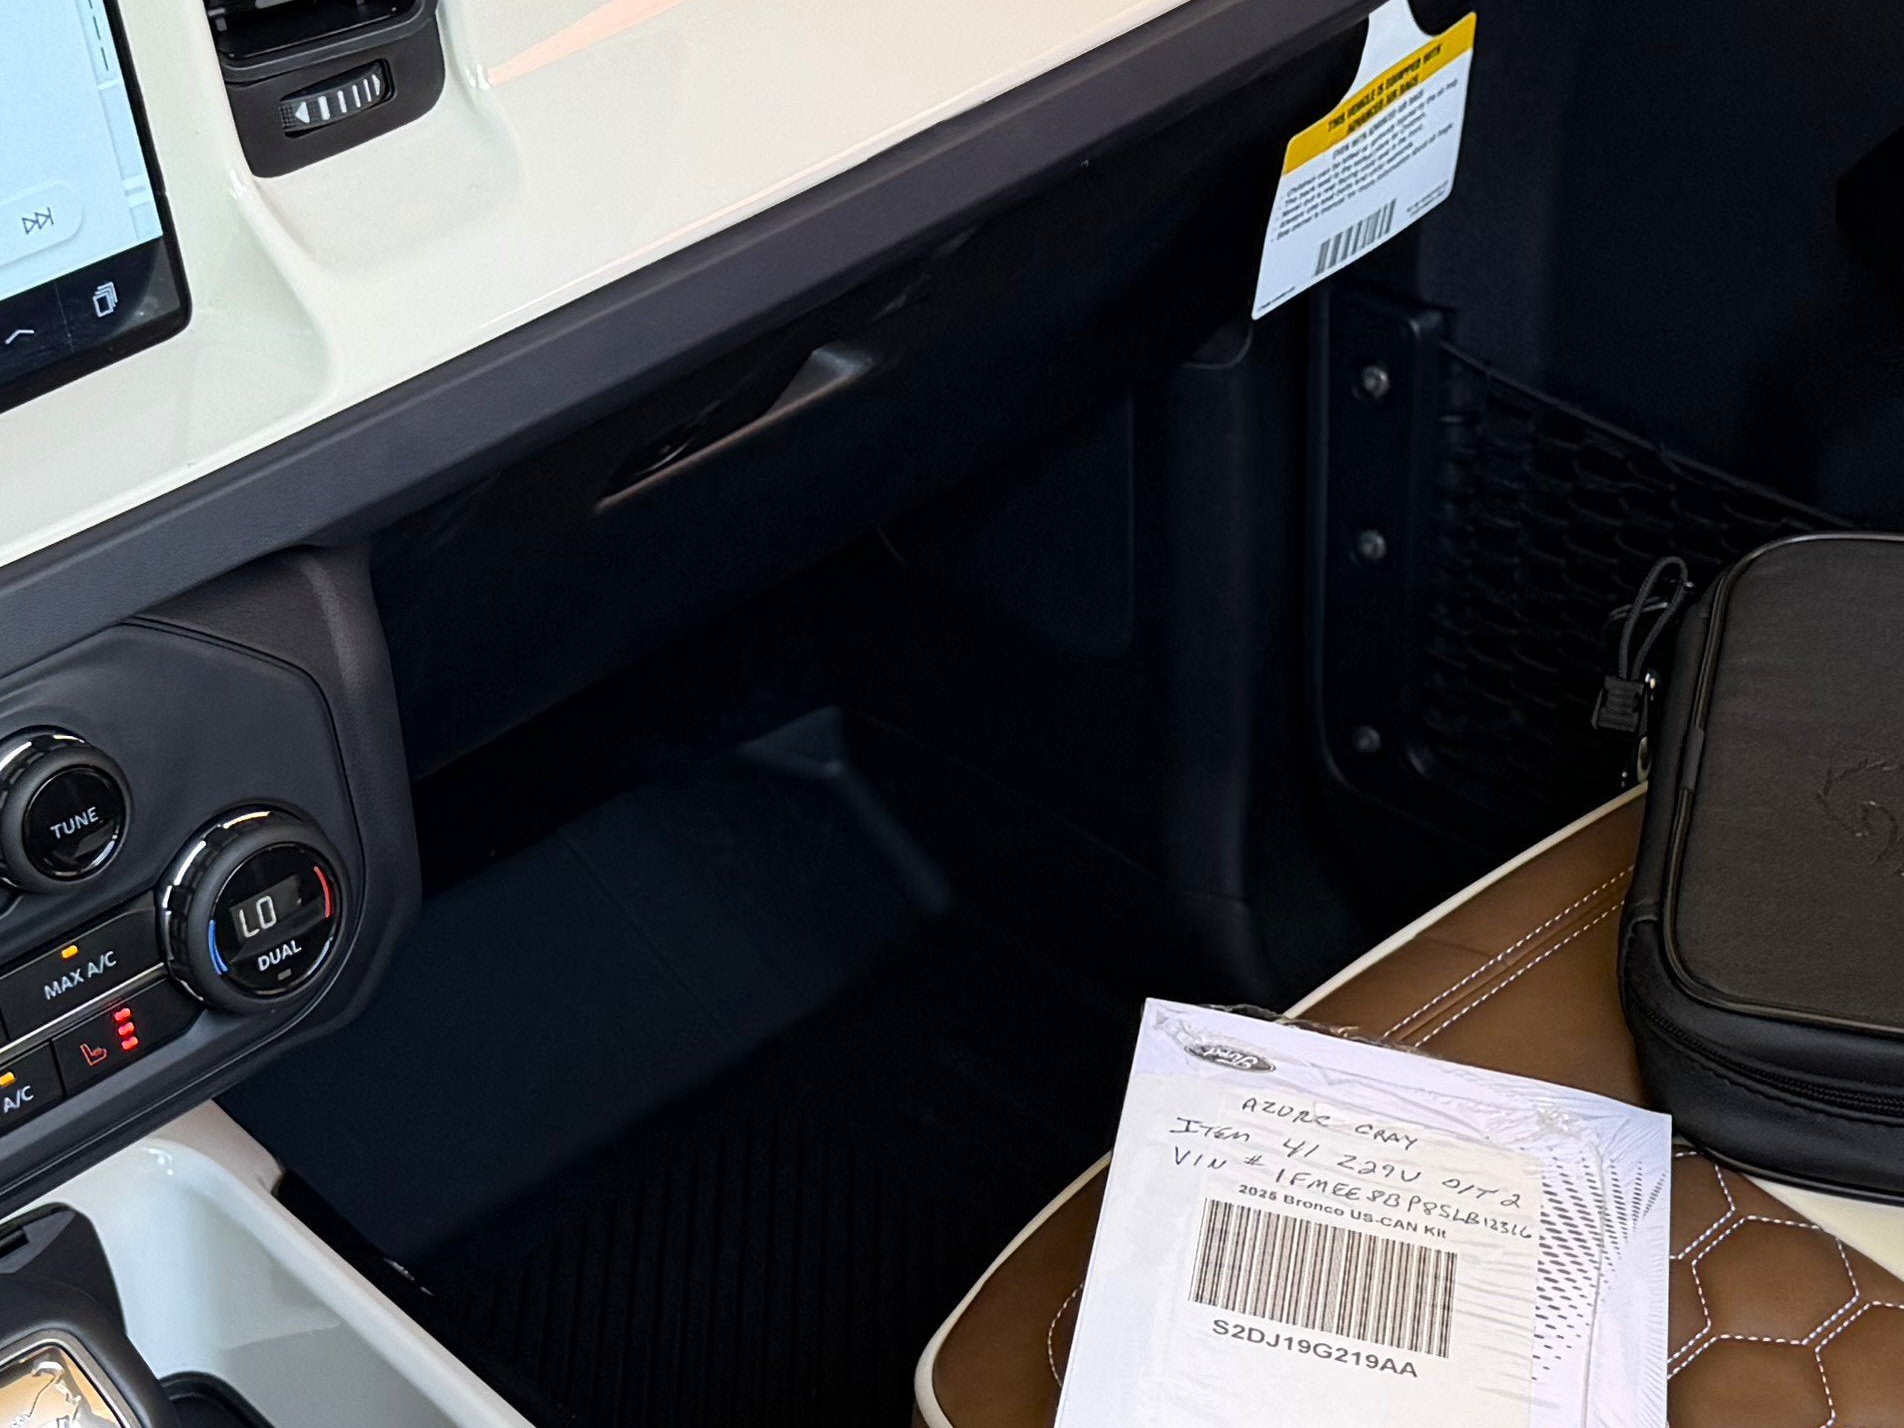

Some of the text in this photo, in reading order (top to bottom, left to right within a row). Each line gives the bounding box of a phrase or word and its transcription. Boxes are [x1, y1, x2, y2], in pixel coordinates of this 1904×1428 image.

[50, 803, 100, 840] TUNE
[239, 895, 278, 939] LO
[43, 949, 118, 1002] MAX A/C
[257, 939, 303, 972] DUAL
[1, 1083, 35, 1115] A/C
[1175, 1146, 1227, 1170] VIN
[1283, 1194, 1345, 1217] Bronco
[1424, 1225, 1447, 1240] Kit
[1211, 1318, 1419, 1378] S2DJ19G219AA
